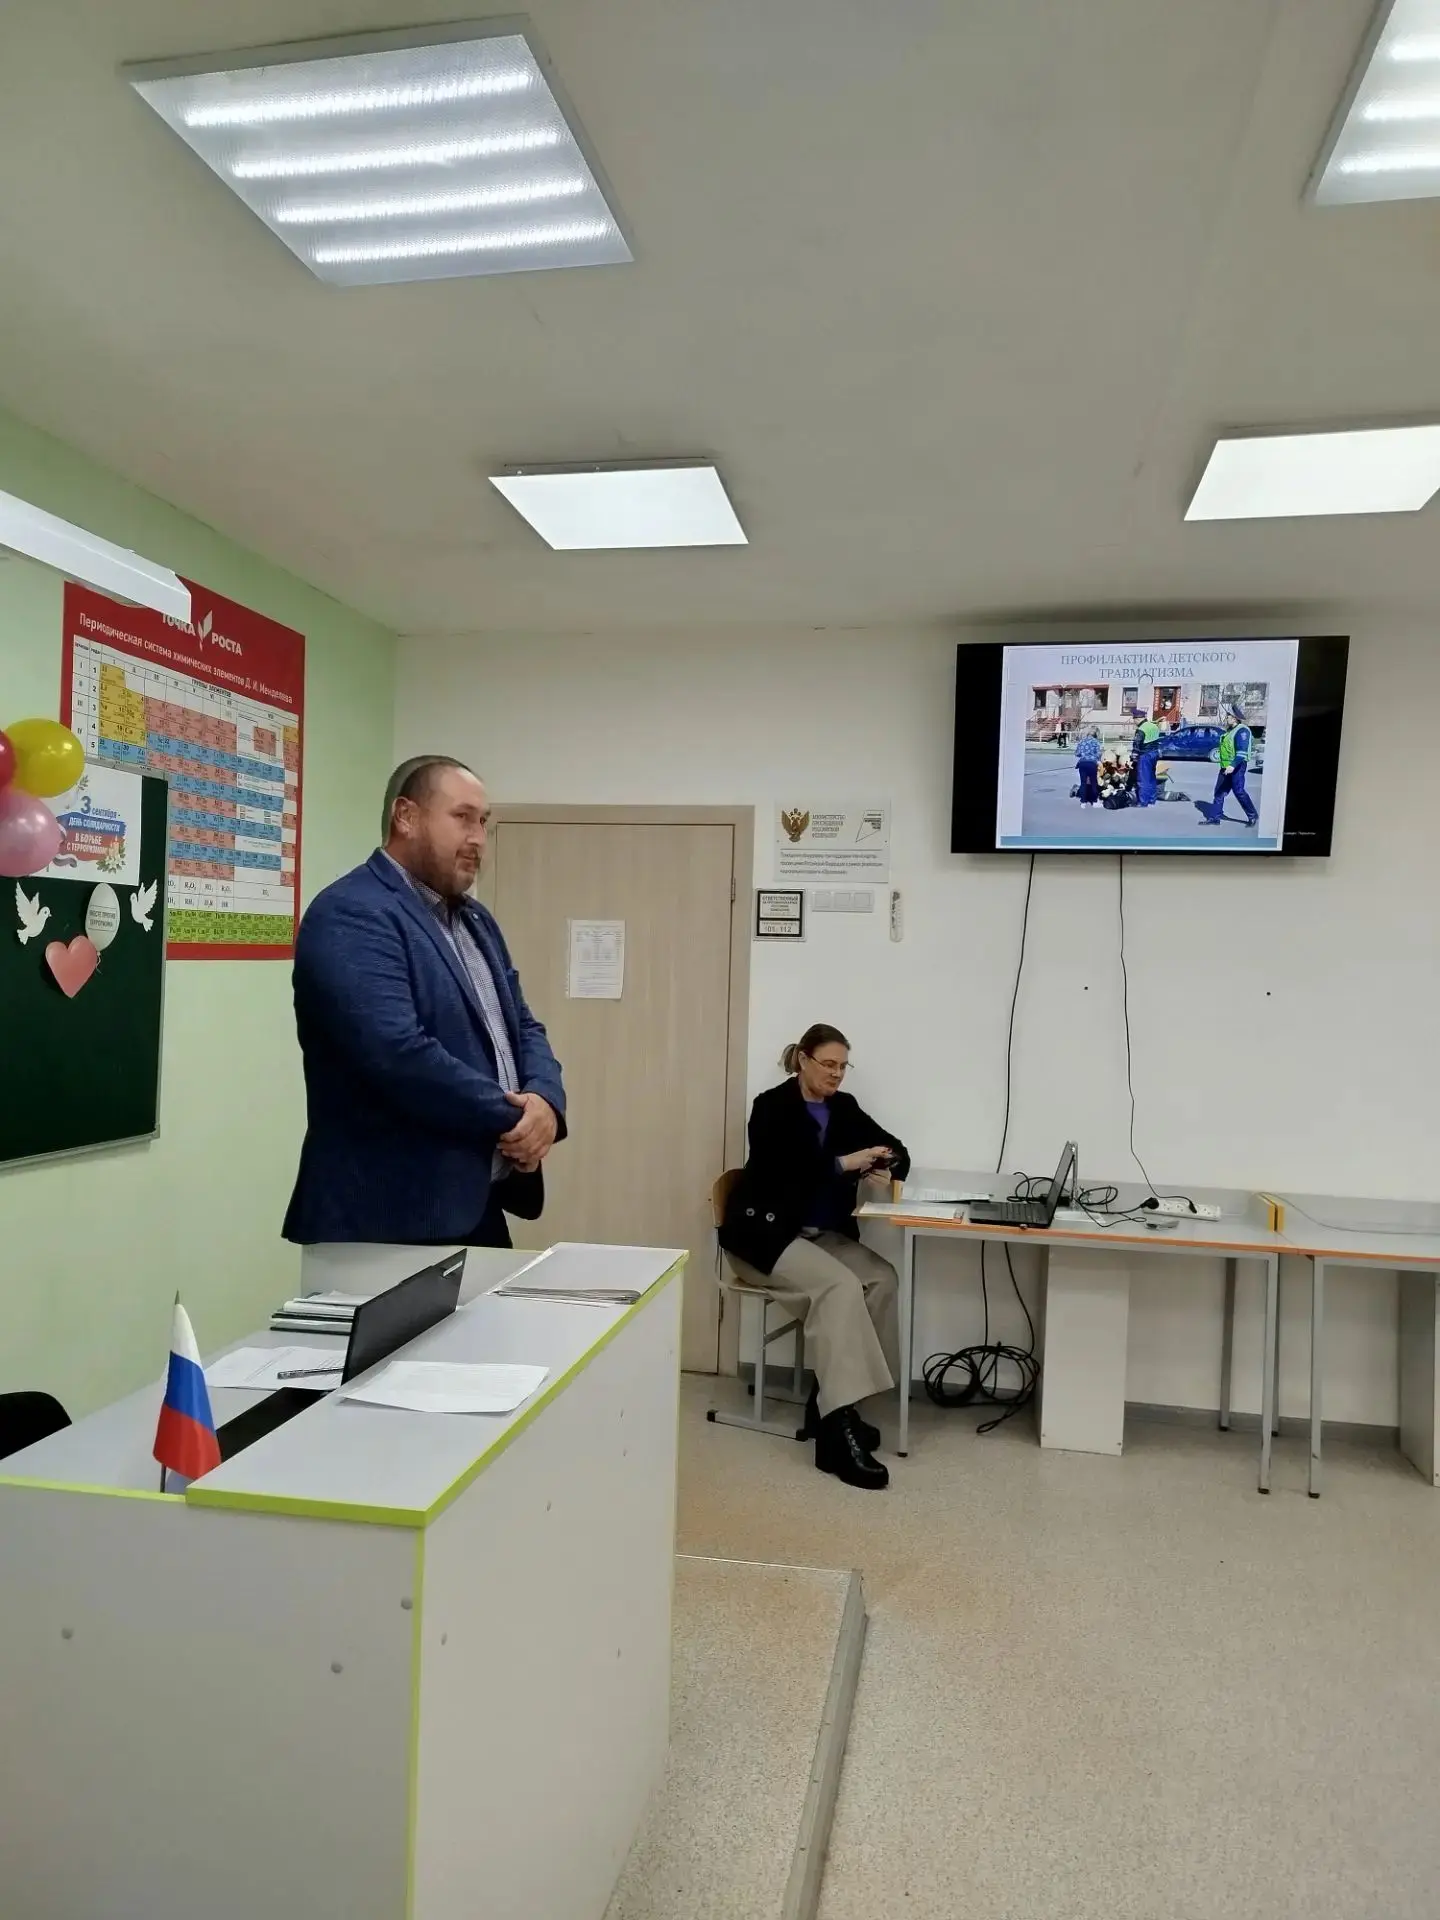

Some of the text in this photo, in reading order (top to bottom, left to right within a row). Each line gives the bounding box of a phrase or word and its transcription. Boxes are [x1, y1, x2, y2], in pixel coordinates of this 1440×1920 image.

[80, 612, 142, 647] Периодическая
[144, 639, 172, 658] система
[173, 651, 212, 674] химических
[213, 667, 245, 686] элементов
[211, 632, 243, 656] РОСТА
[1061, 651, 1236, 665] ПРОФИЛАКТИКА ДЕТСКОГО
[1099, 666, 1195, 679] ТРАВМАТИЗМА
[90, 741, 96, 749] 5
[80, 795, 91, 814] 3
[68, 816, 83, 828] ДЕНЬ
[75, 832, 102, 845] В БОРЬБЕ
[66, 842, 71, 851] С
